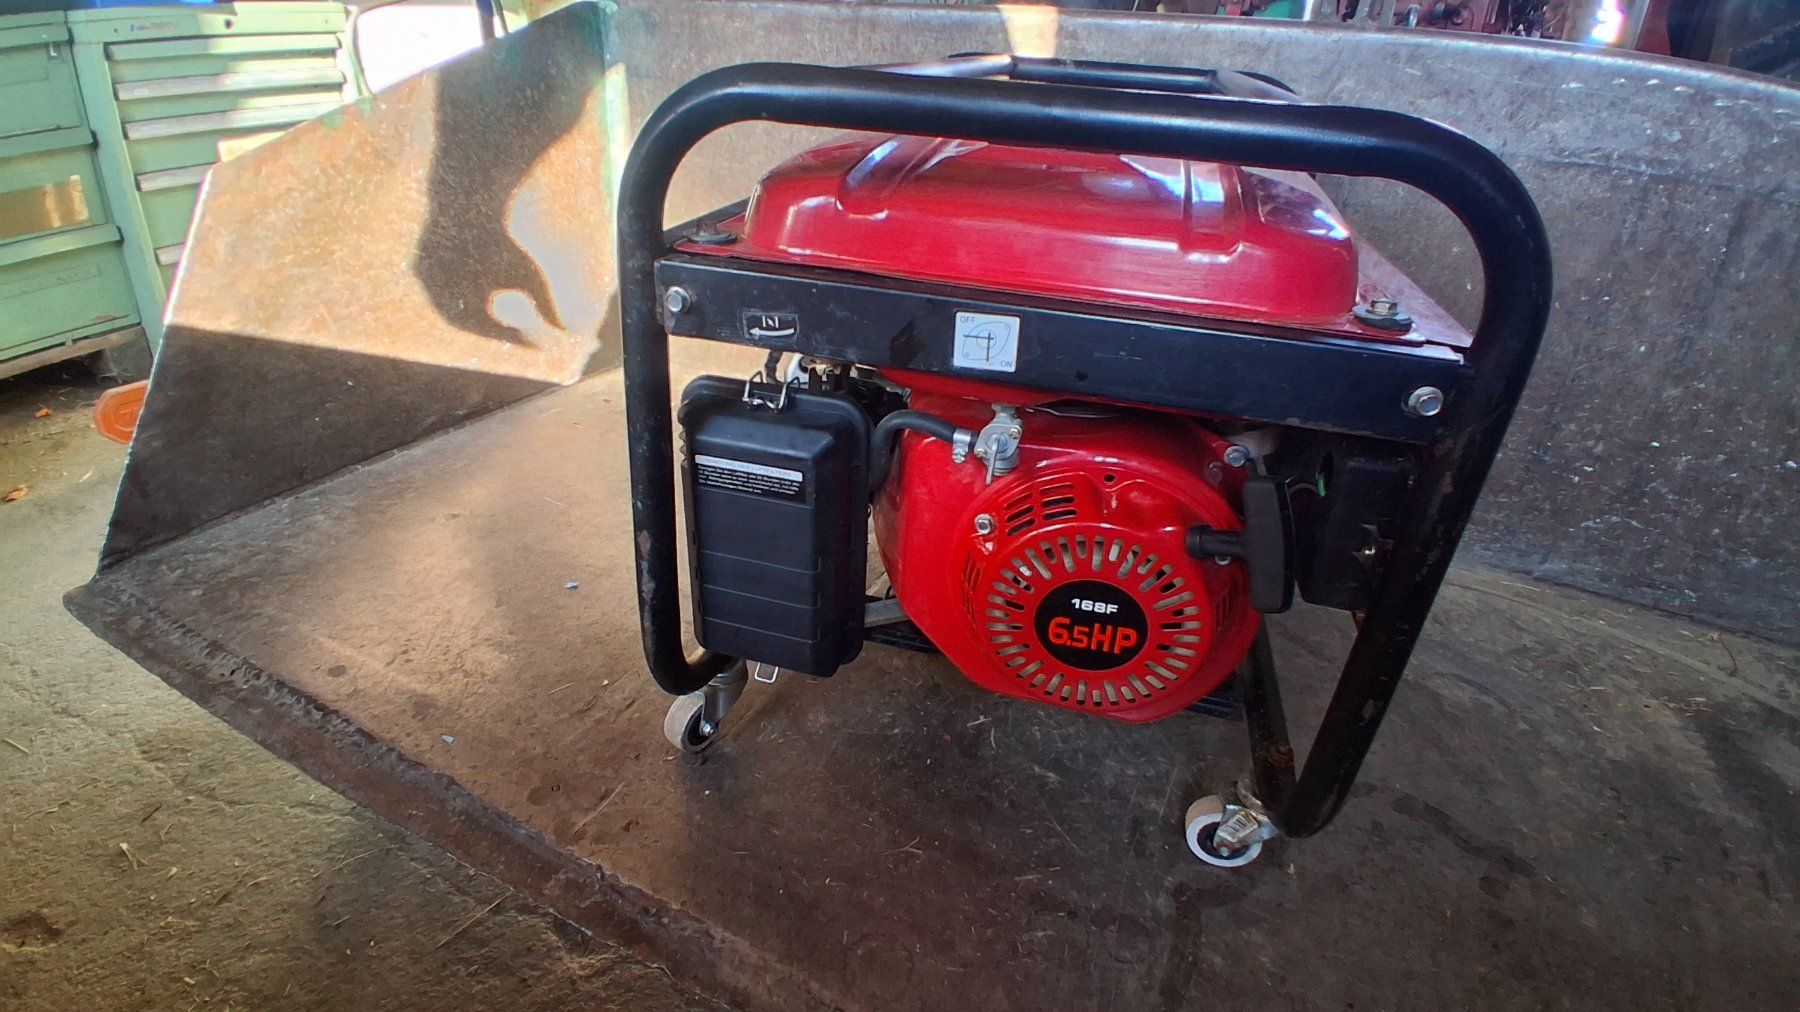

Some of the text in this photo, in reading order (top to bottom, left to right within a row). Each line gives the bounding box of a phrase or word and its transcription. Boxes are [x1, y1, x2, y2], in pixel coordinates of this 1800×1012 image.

[960, 315, 976, 324] OFF
[1000, 360, 1013, 369] ON
[1071, 598, 1119, 615] 168F
[1048, 616, 1137, 654] 6.5HP
